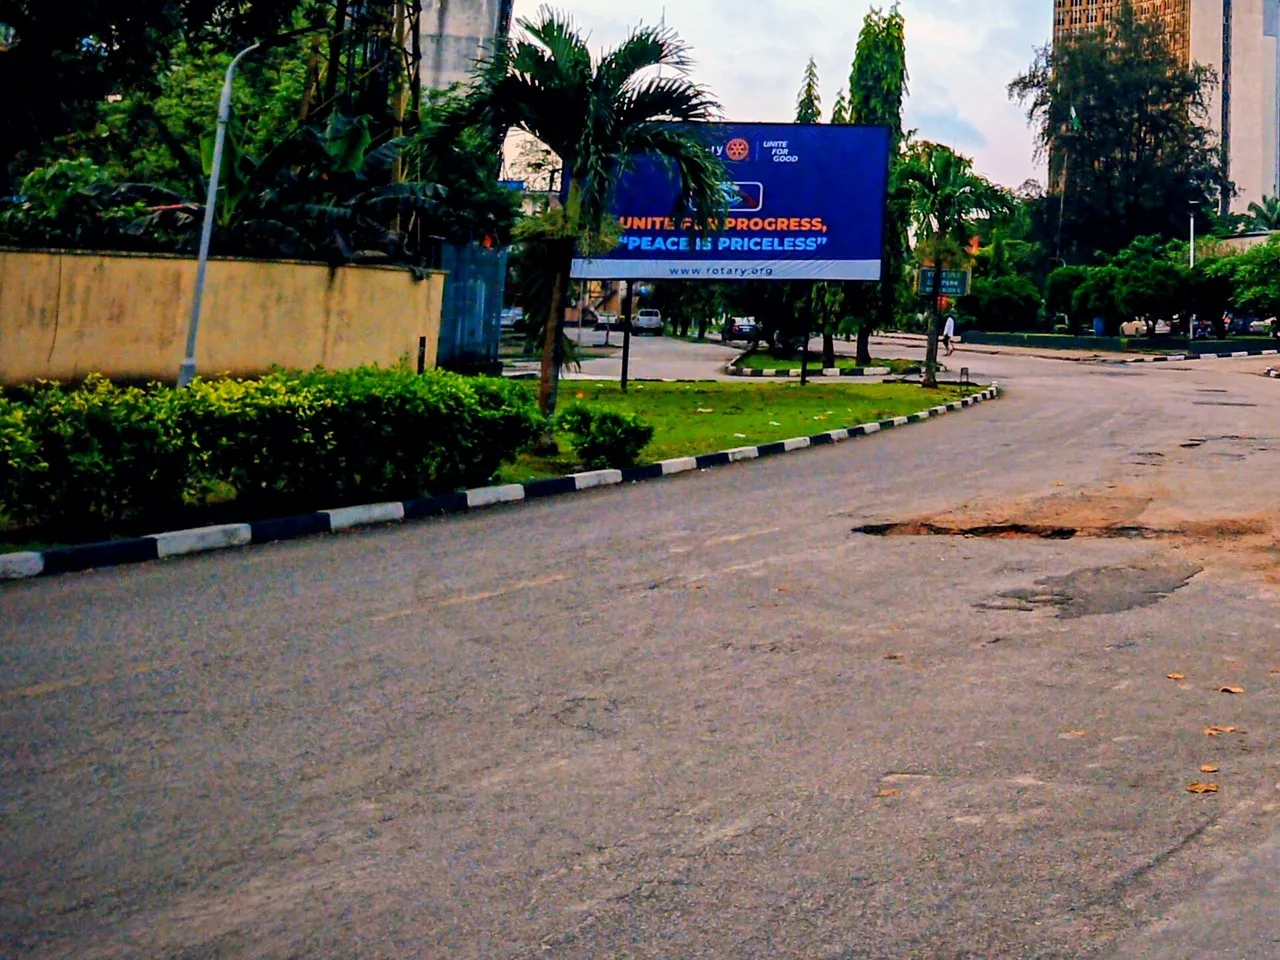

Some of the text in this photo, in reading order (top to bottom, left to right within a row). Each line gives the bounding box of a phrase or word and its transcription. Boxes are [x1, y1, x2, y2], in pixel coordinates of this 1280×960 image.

[619, 217, 675, 230] UNITE
[724, 218, 827, 233] PROGRESS,
[696, 237, 712, 250] IS
